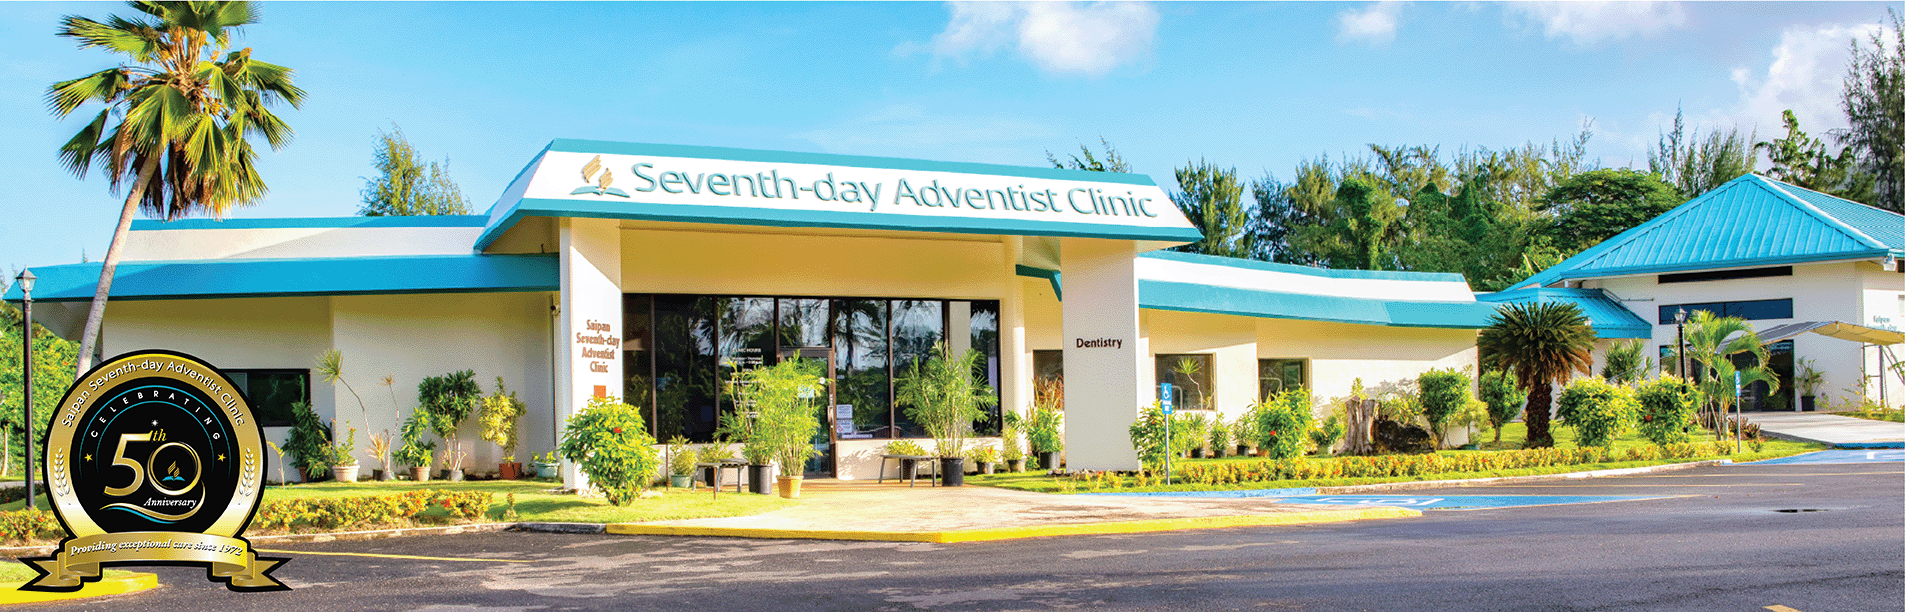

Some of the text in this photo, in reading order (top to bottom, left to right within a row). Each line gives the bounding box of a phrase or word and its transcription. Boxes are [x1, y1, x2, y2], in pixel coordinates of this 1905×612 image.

[631, 162, 1158, 218] Seventh-day Adventist Clinic
[586, 319, 611, 334] Saipan
[576, 332, 620, 349] Seventh-day
[1076, 337, 1122, 349] Dentistry
[581, 347, 615, 360] Adventist
[590, 361, 608, 373] Clinic
